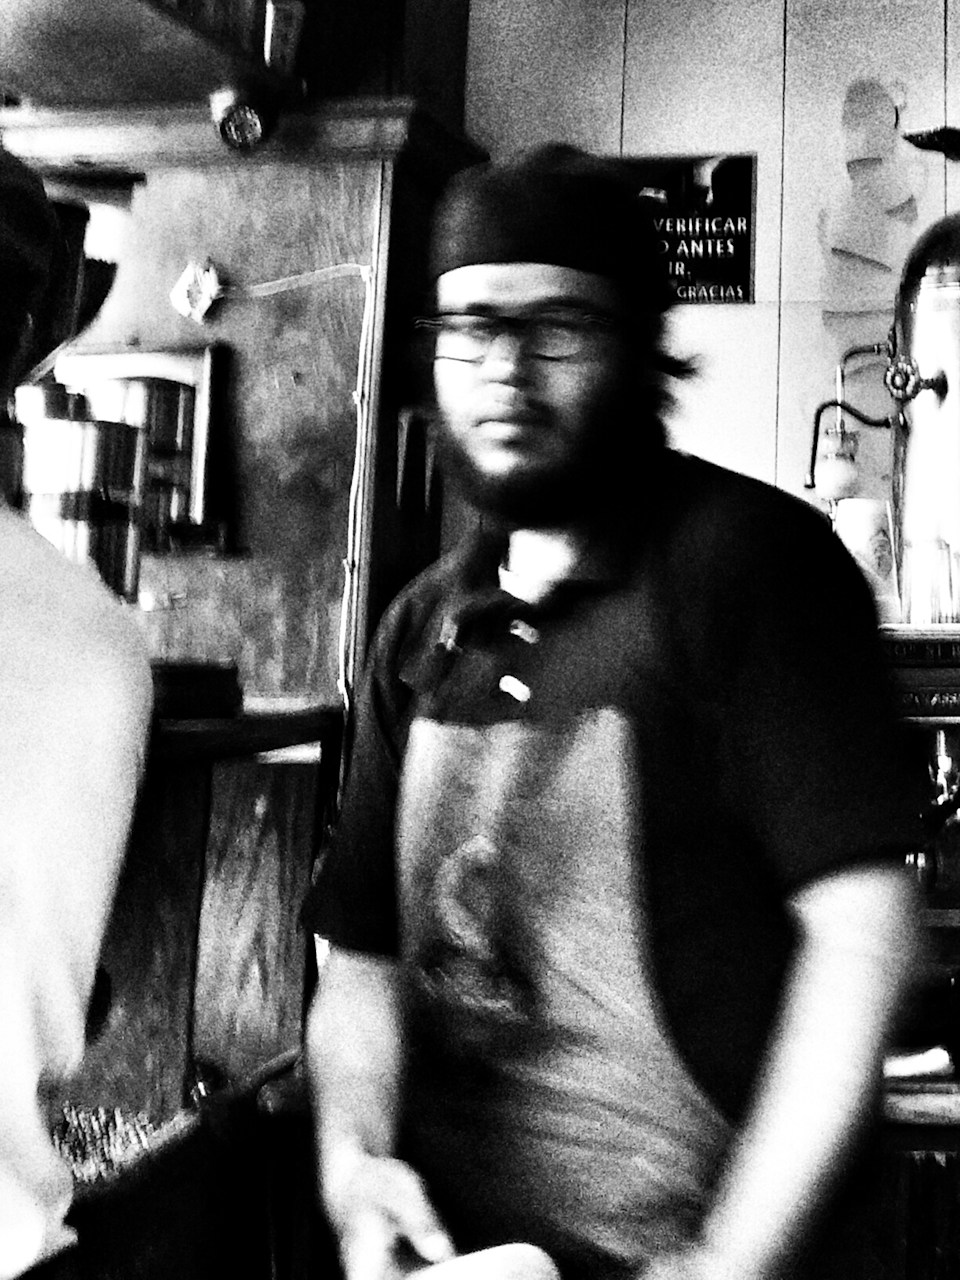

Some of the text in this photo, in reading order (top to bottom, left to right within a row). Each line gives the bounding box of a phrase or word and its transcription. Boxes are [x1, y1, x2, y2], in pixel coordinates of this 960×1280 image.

[653, 217, 746, 235] VERIFICAR
[677, 239, 734, 257] ANTES
[677, 286, 742, 302] GRACIAS
